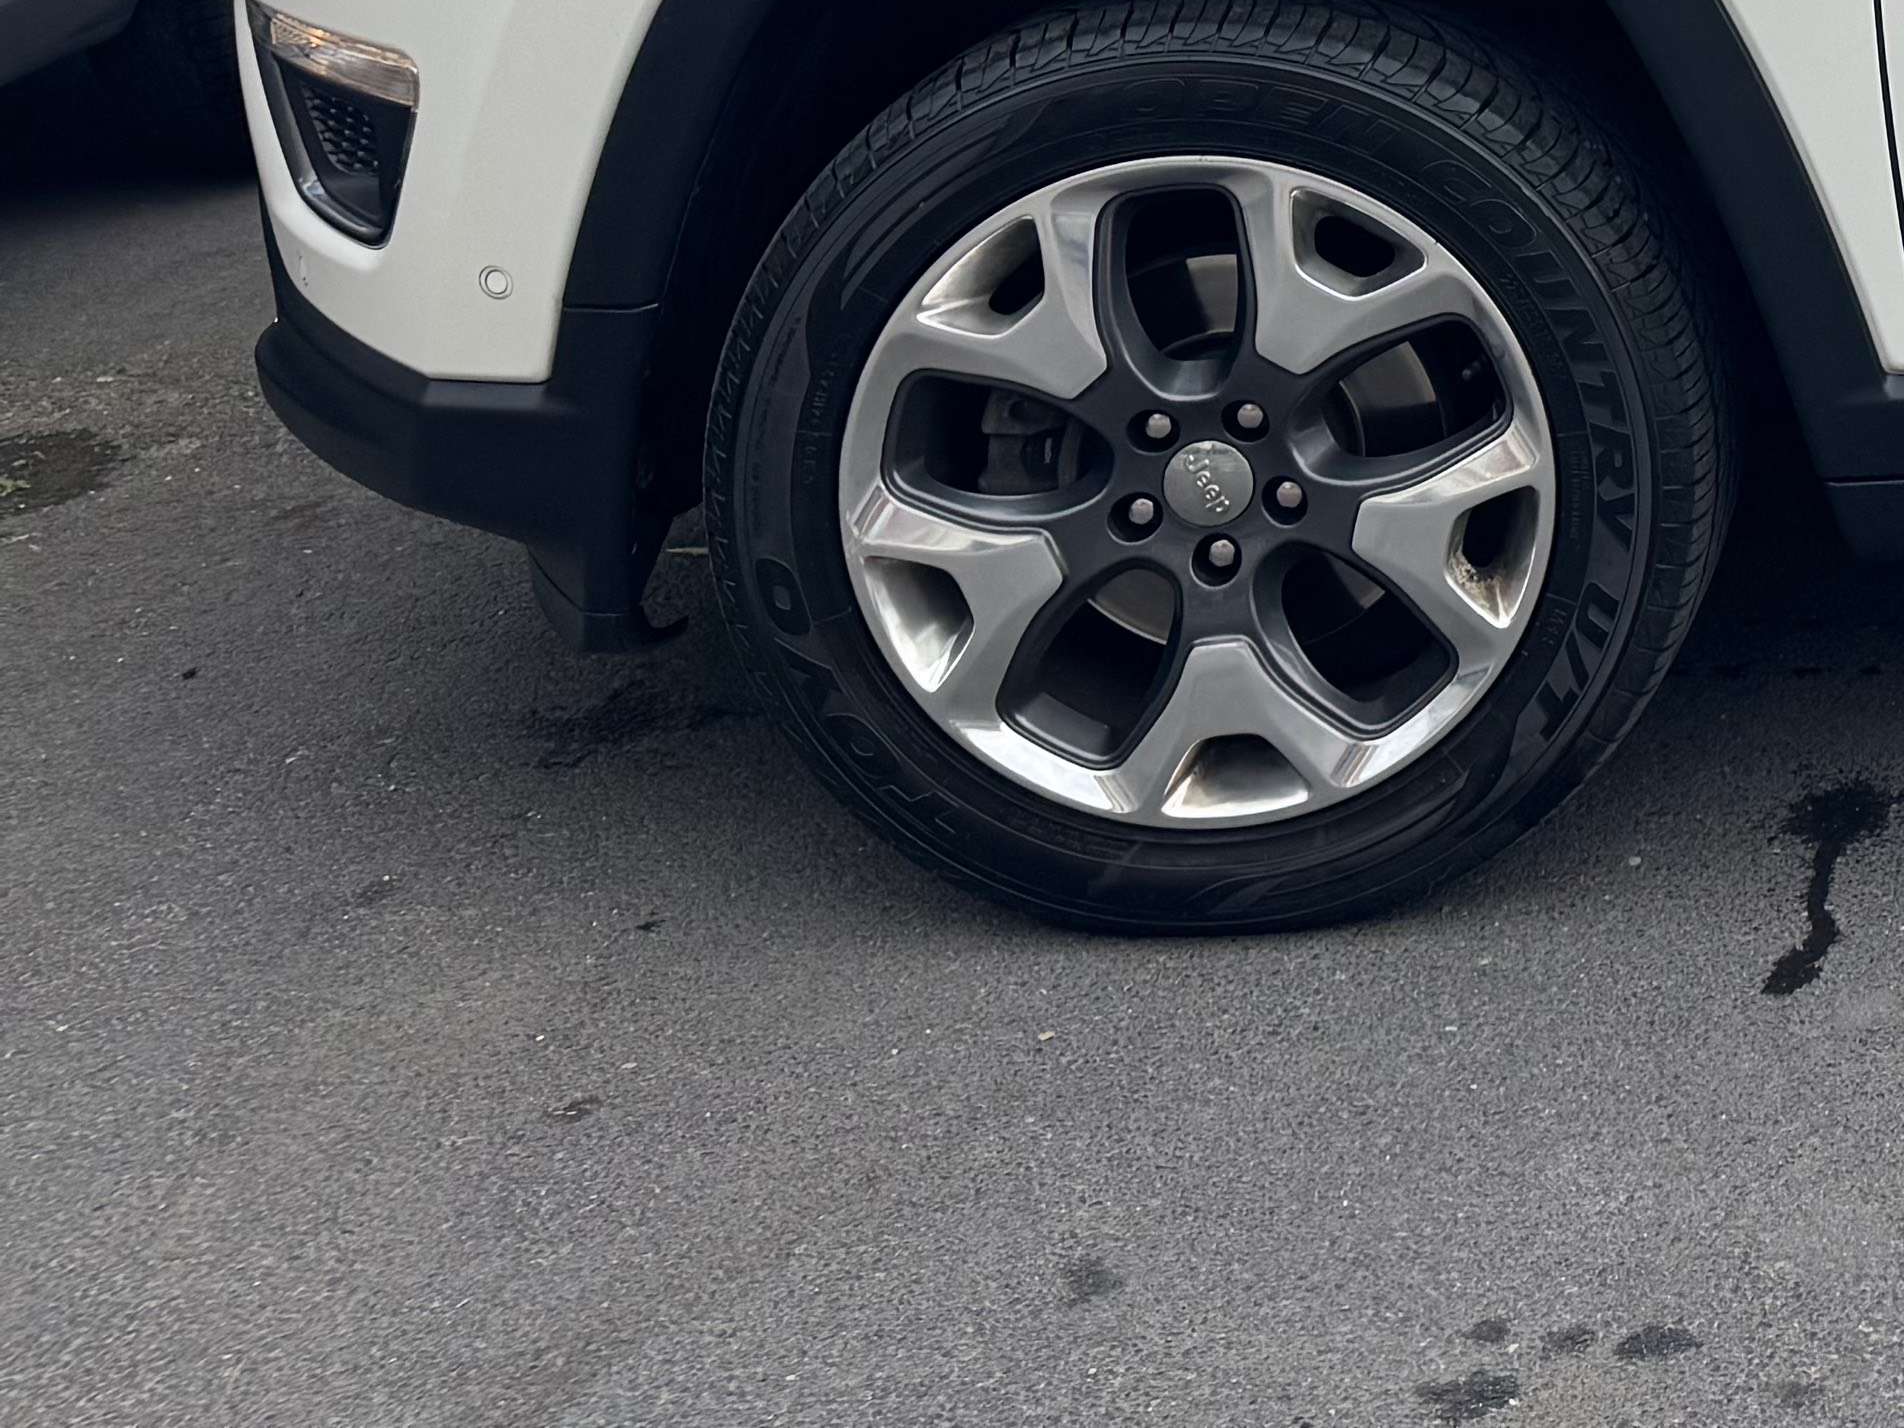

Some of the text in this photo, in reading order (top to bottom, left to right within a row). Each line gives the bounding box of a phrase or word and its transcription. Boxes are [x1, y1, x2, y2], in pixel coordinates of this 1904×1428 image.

[1183, 451, 1232, 515] Jeep
[1424, 153, 1635, 554] COUNTRY
[1537, 580, 1620, 744] U/T
[754, 555, 962, 840] TOYO
